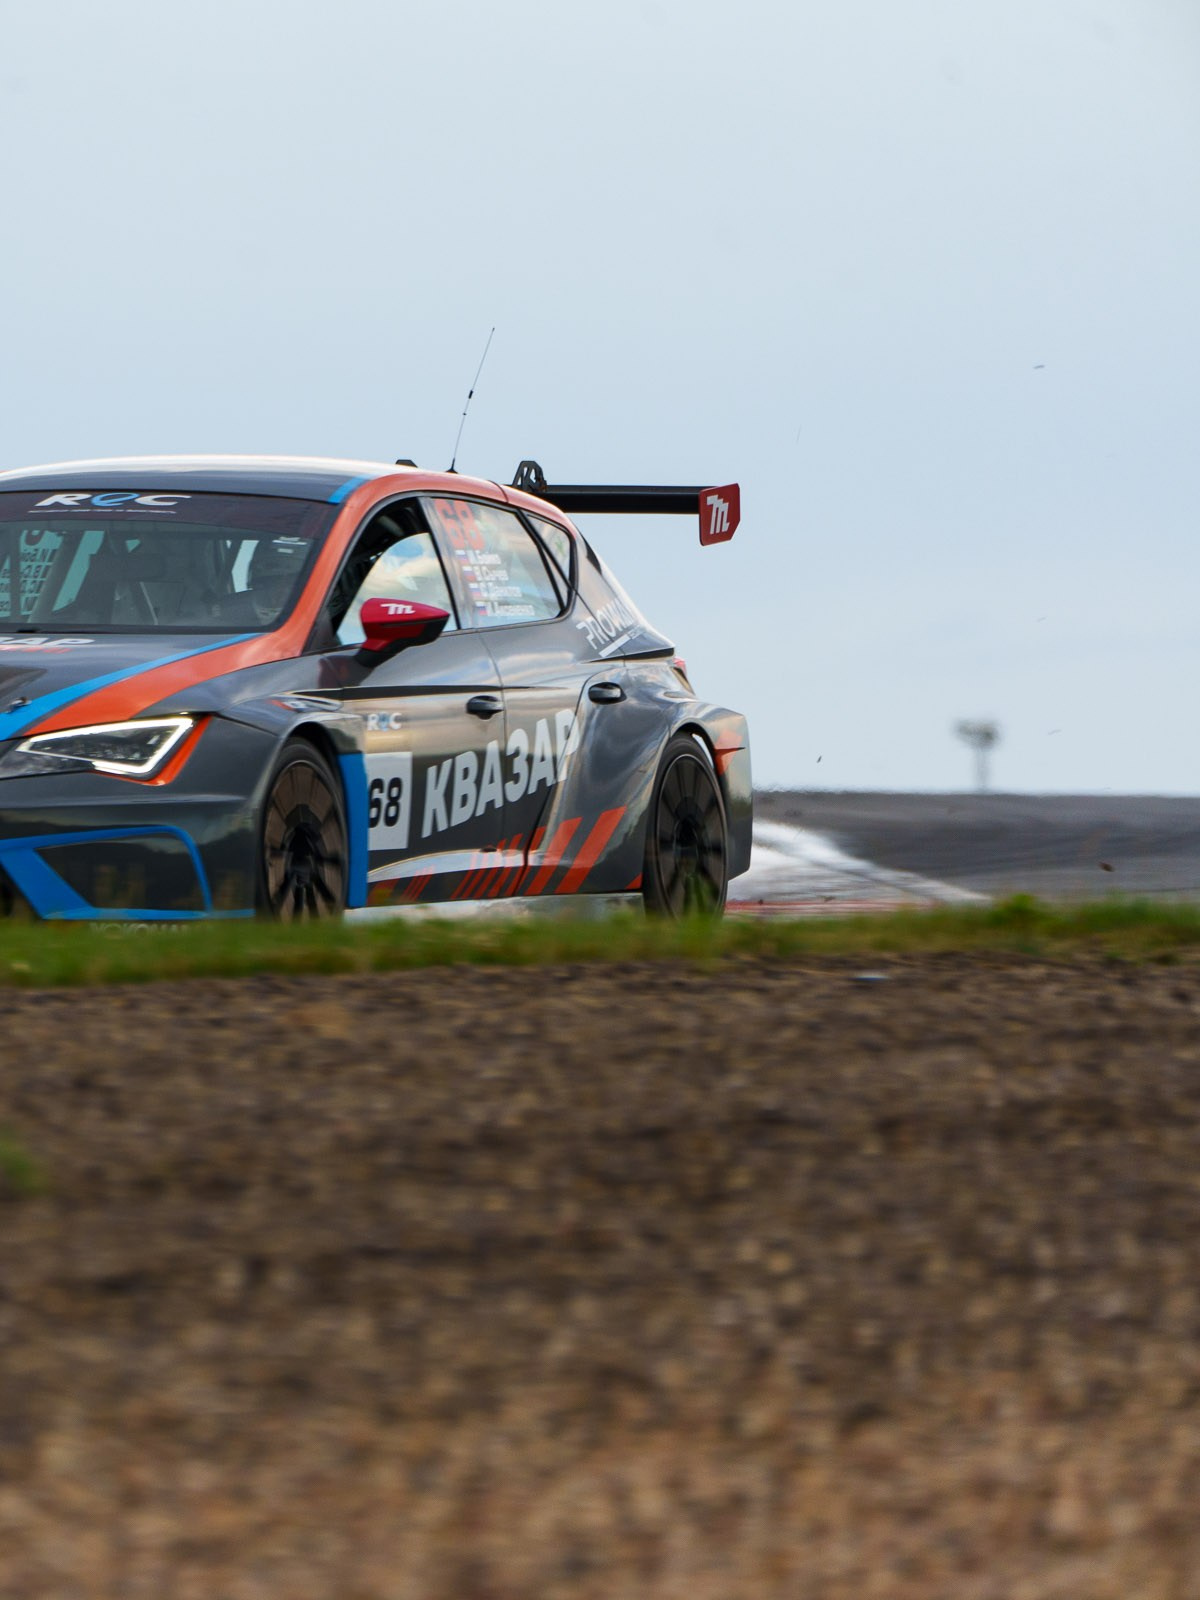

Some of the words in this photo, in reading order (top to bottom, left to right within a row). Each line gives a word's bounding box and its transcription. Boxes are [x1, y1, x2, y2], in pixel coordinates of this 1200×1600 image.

[434, 499, 486, 550] 68
[421, 708, 581, 839] КВАЗАР
[369, 776, 403, 829] 68
